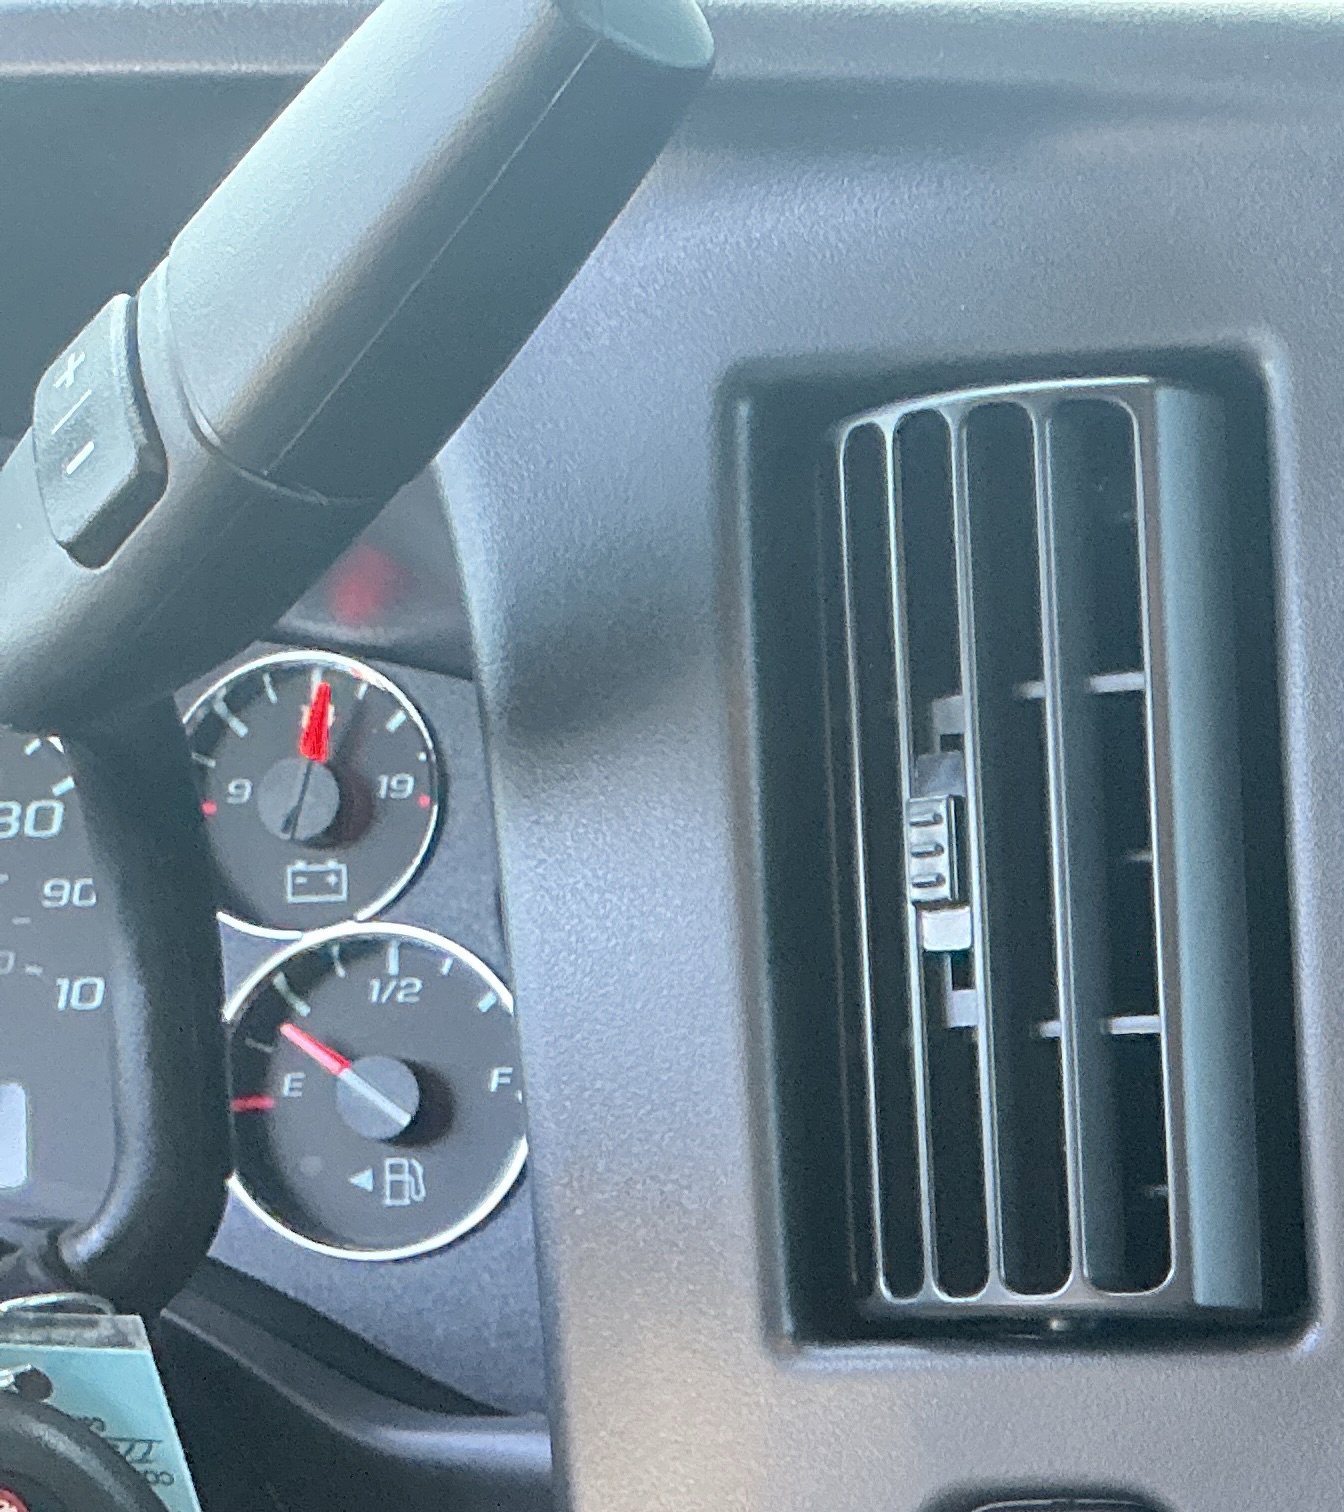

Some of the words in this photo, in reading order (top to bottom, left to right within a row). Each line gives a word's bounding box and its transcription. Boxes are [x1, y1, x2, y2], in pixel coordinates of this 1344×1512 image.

[229, 780, 251, 802] 9
[380, 774, 414, 798] 19
[43, 878, 96, 907] 90
[370, 978, 422, 1003] 1/2
[282, 1073, 304, 1097] E
[490, 1067, 512, 1092] F
